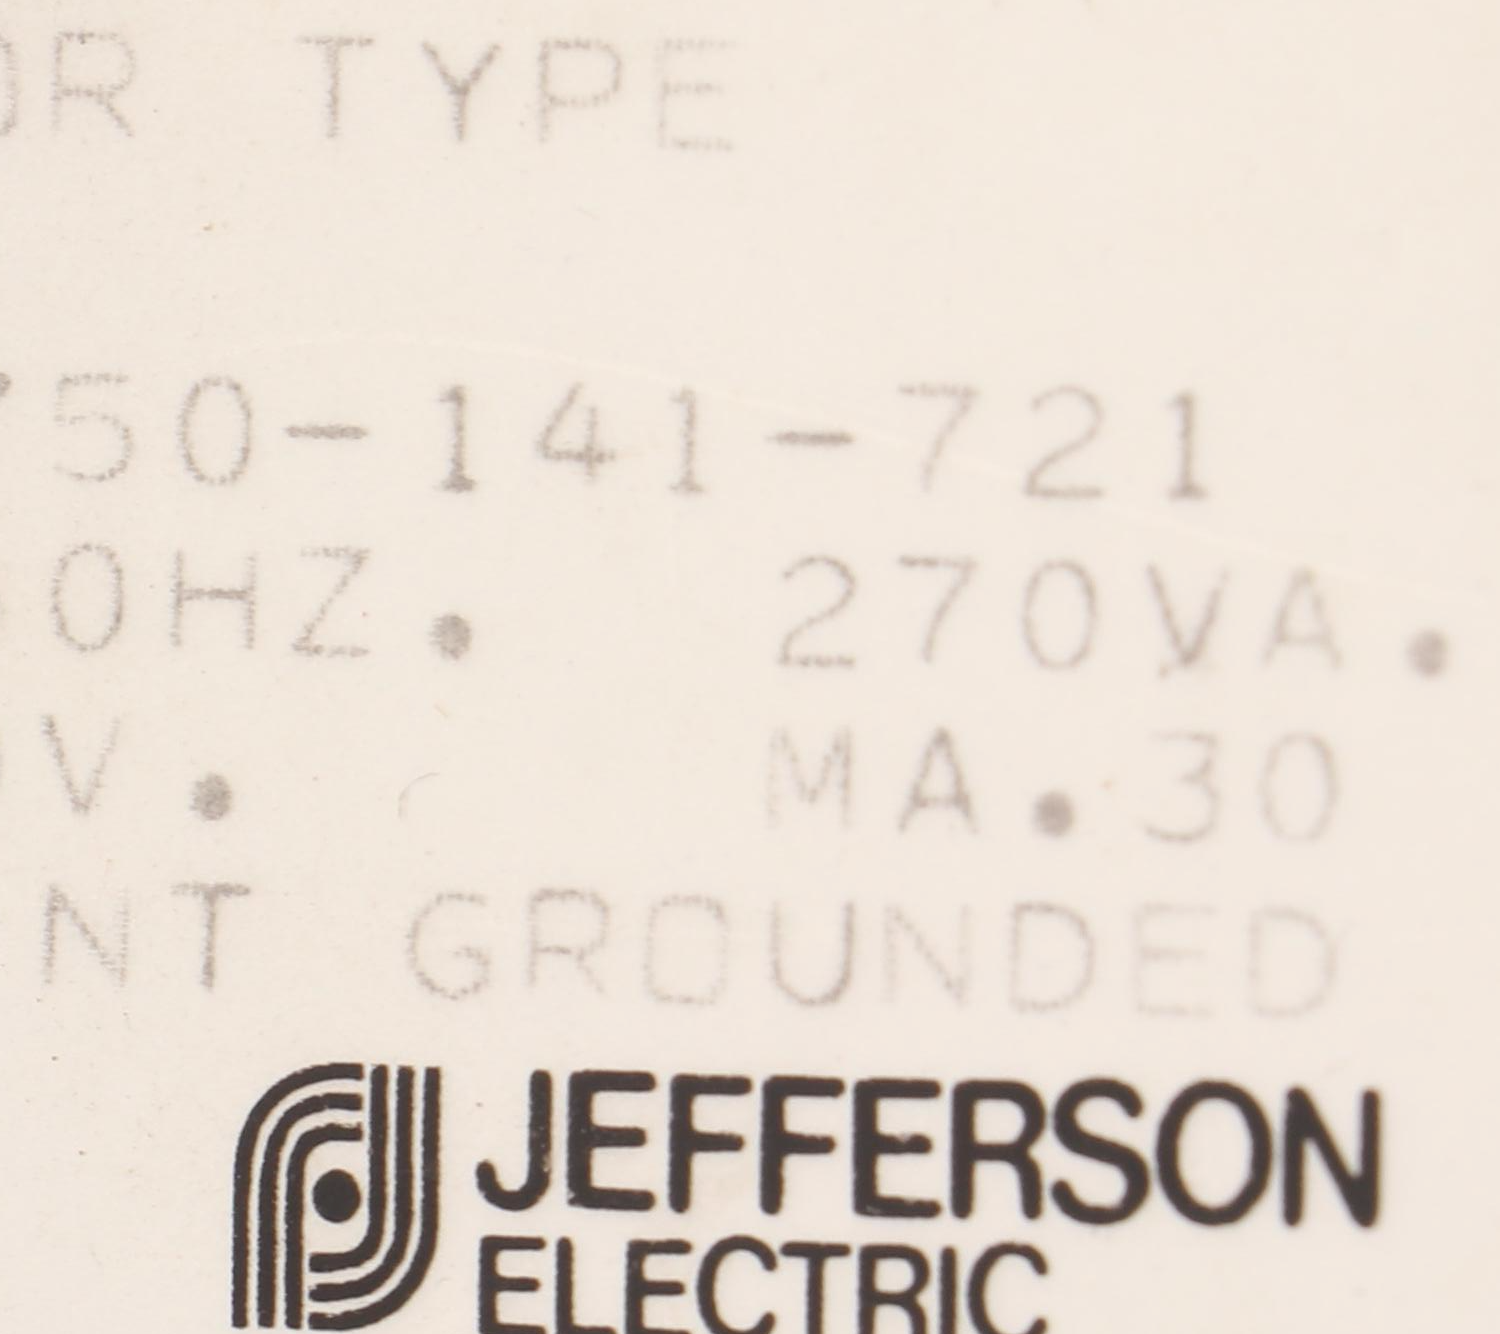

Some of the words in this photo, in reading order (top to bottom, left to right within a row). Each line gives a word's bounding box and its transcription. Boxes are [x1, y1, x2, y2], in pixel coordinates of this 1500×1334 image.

[305, 37, 733, 151] TYPE
[779, 556, 1448, 680] 270VA.
[770, 728, 1339, 845] MA.30
[407, 888, 1339, 1016] GROUNDED
[474, 1070, 1389, 1229] JEFFERSON
